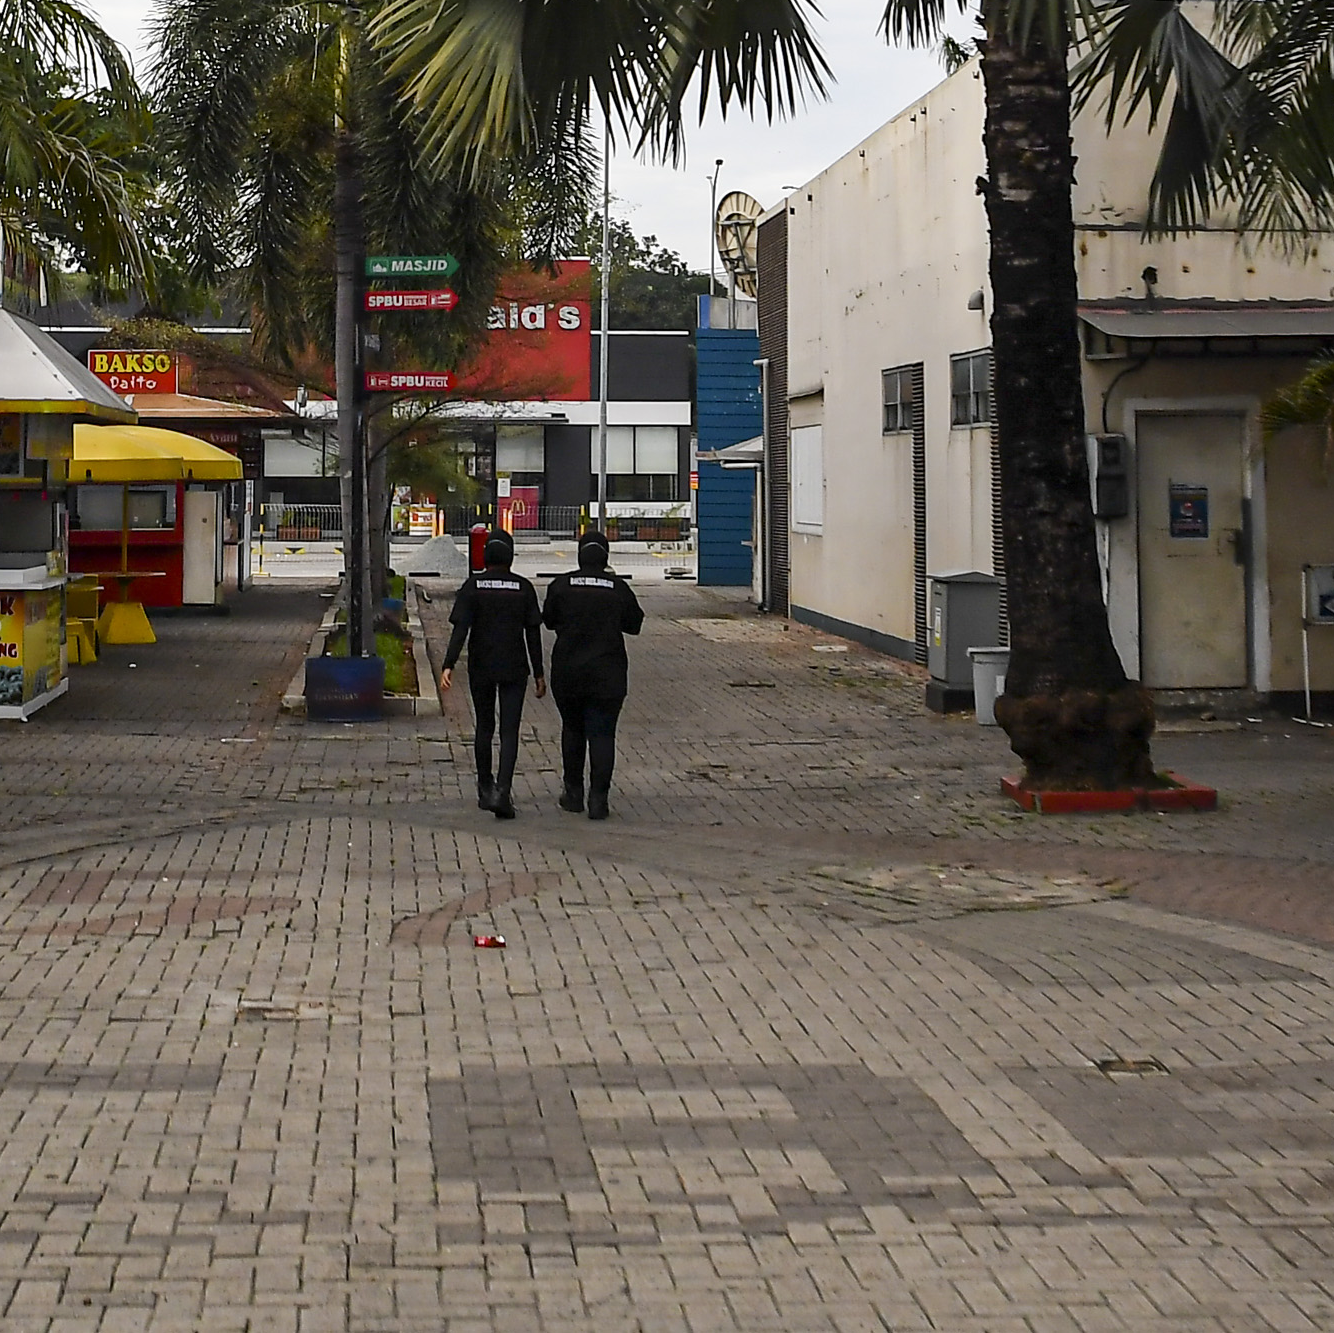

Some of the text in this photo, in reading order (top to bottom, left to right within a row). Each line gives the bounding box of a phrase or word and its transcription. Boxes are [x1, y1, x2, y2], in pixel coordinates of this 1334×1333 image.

[391, 260, 448, 272] MASJID
[368, 295, 403, 307] SPBU
[94, 354, 171, 373] BAKSO
[390, 375, 424, 387] SPBU
